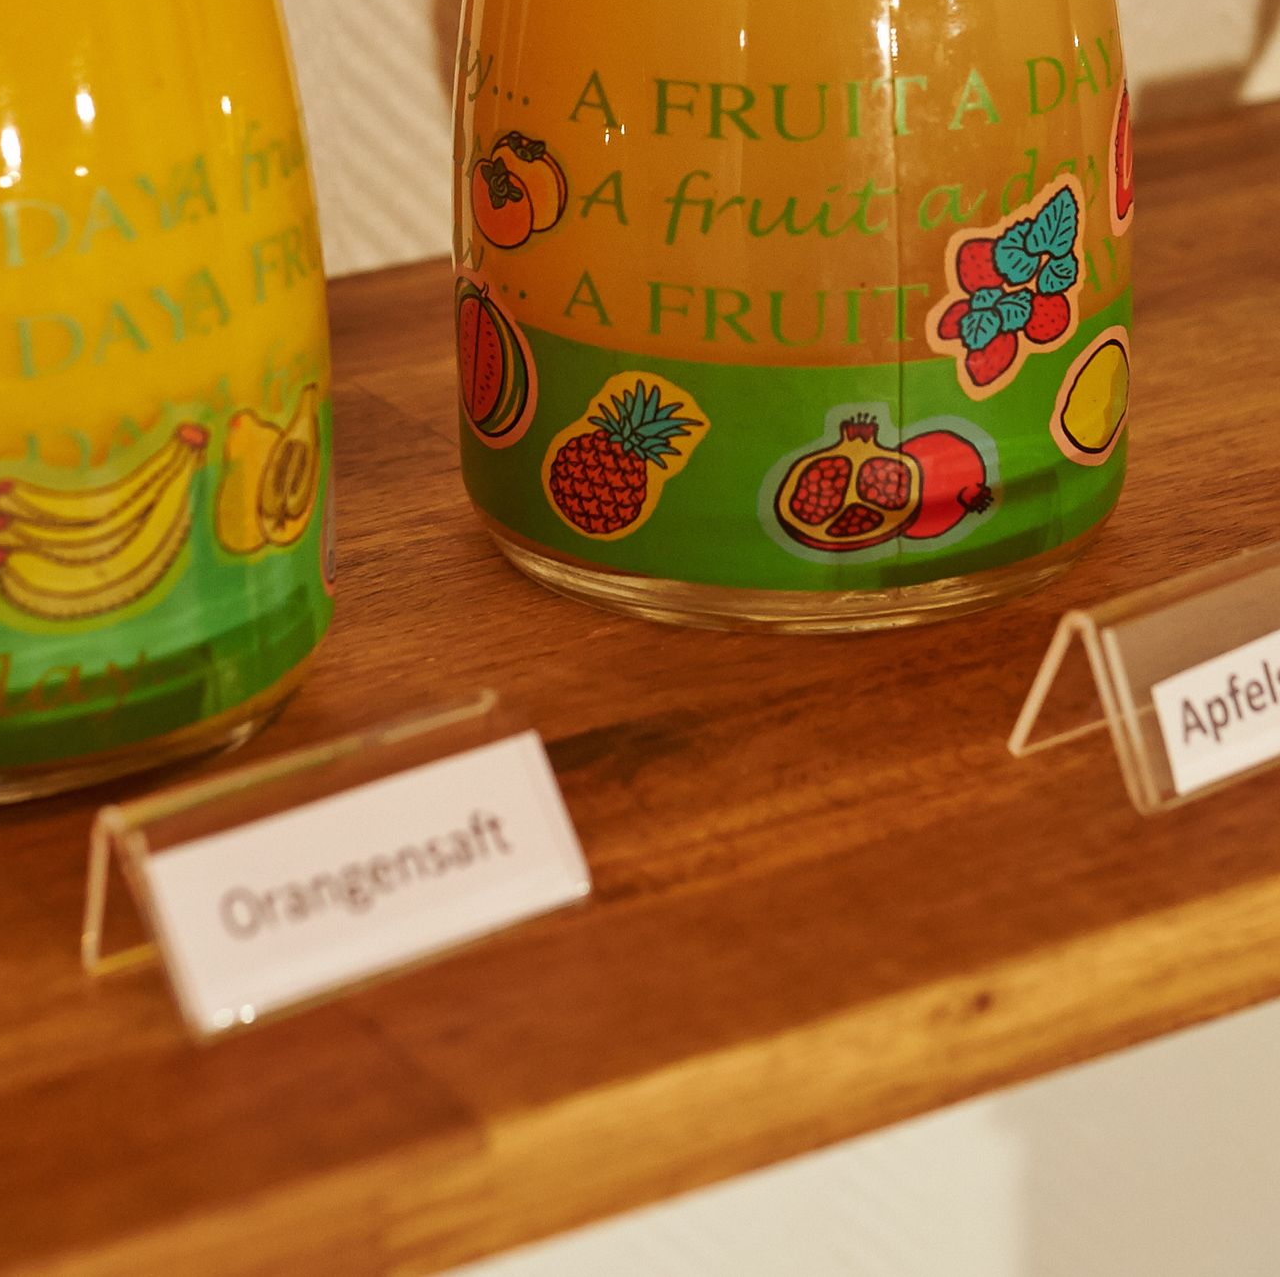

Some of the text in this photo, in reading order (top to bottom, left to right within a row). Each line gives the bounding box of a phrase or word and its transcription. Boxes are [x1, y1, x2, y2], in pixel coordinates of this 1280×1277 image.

[568, 68, 619, 130] A
[652, 76, 928, 143] FRUIT
[947, 68, 1001, 132] A
[580, 169, 630, 226] A
[664, 170, 898, 245] fruit
[917, 183, 988, 232] a
[563, 269, 613, 327] A
[648, 281, 929, 347] FRUIT
[219, 809, 515, 941] Orangensaft
